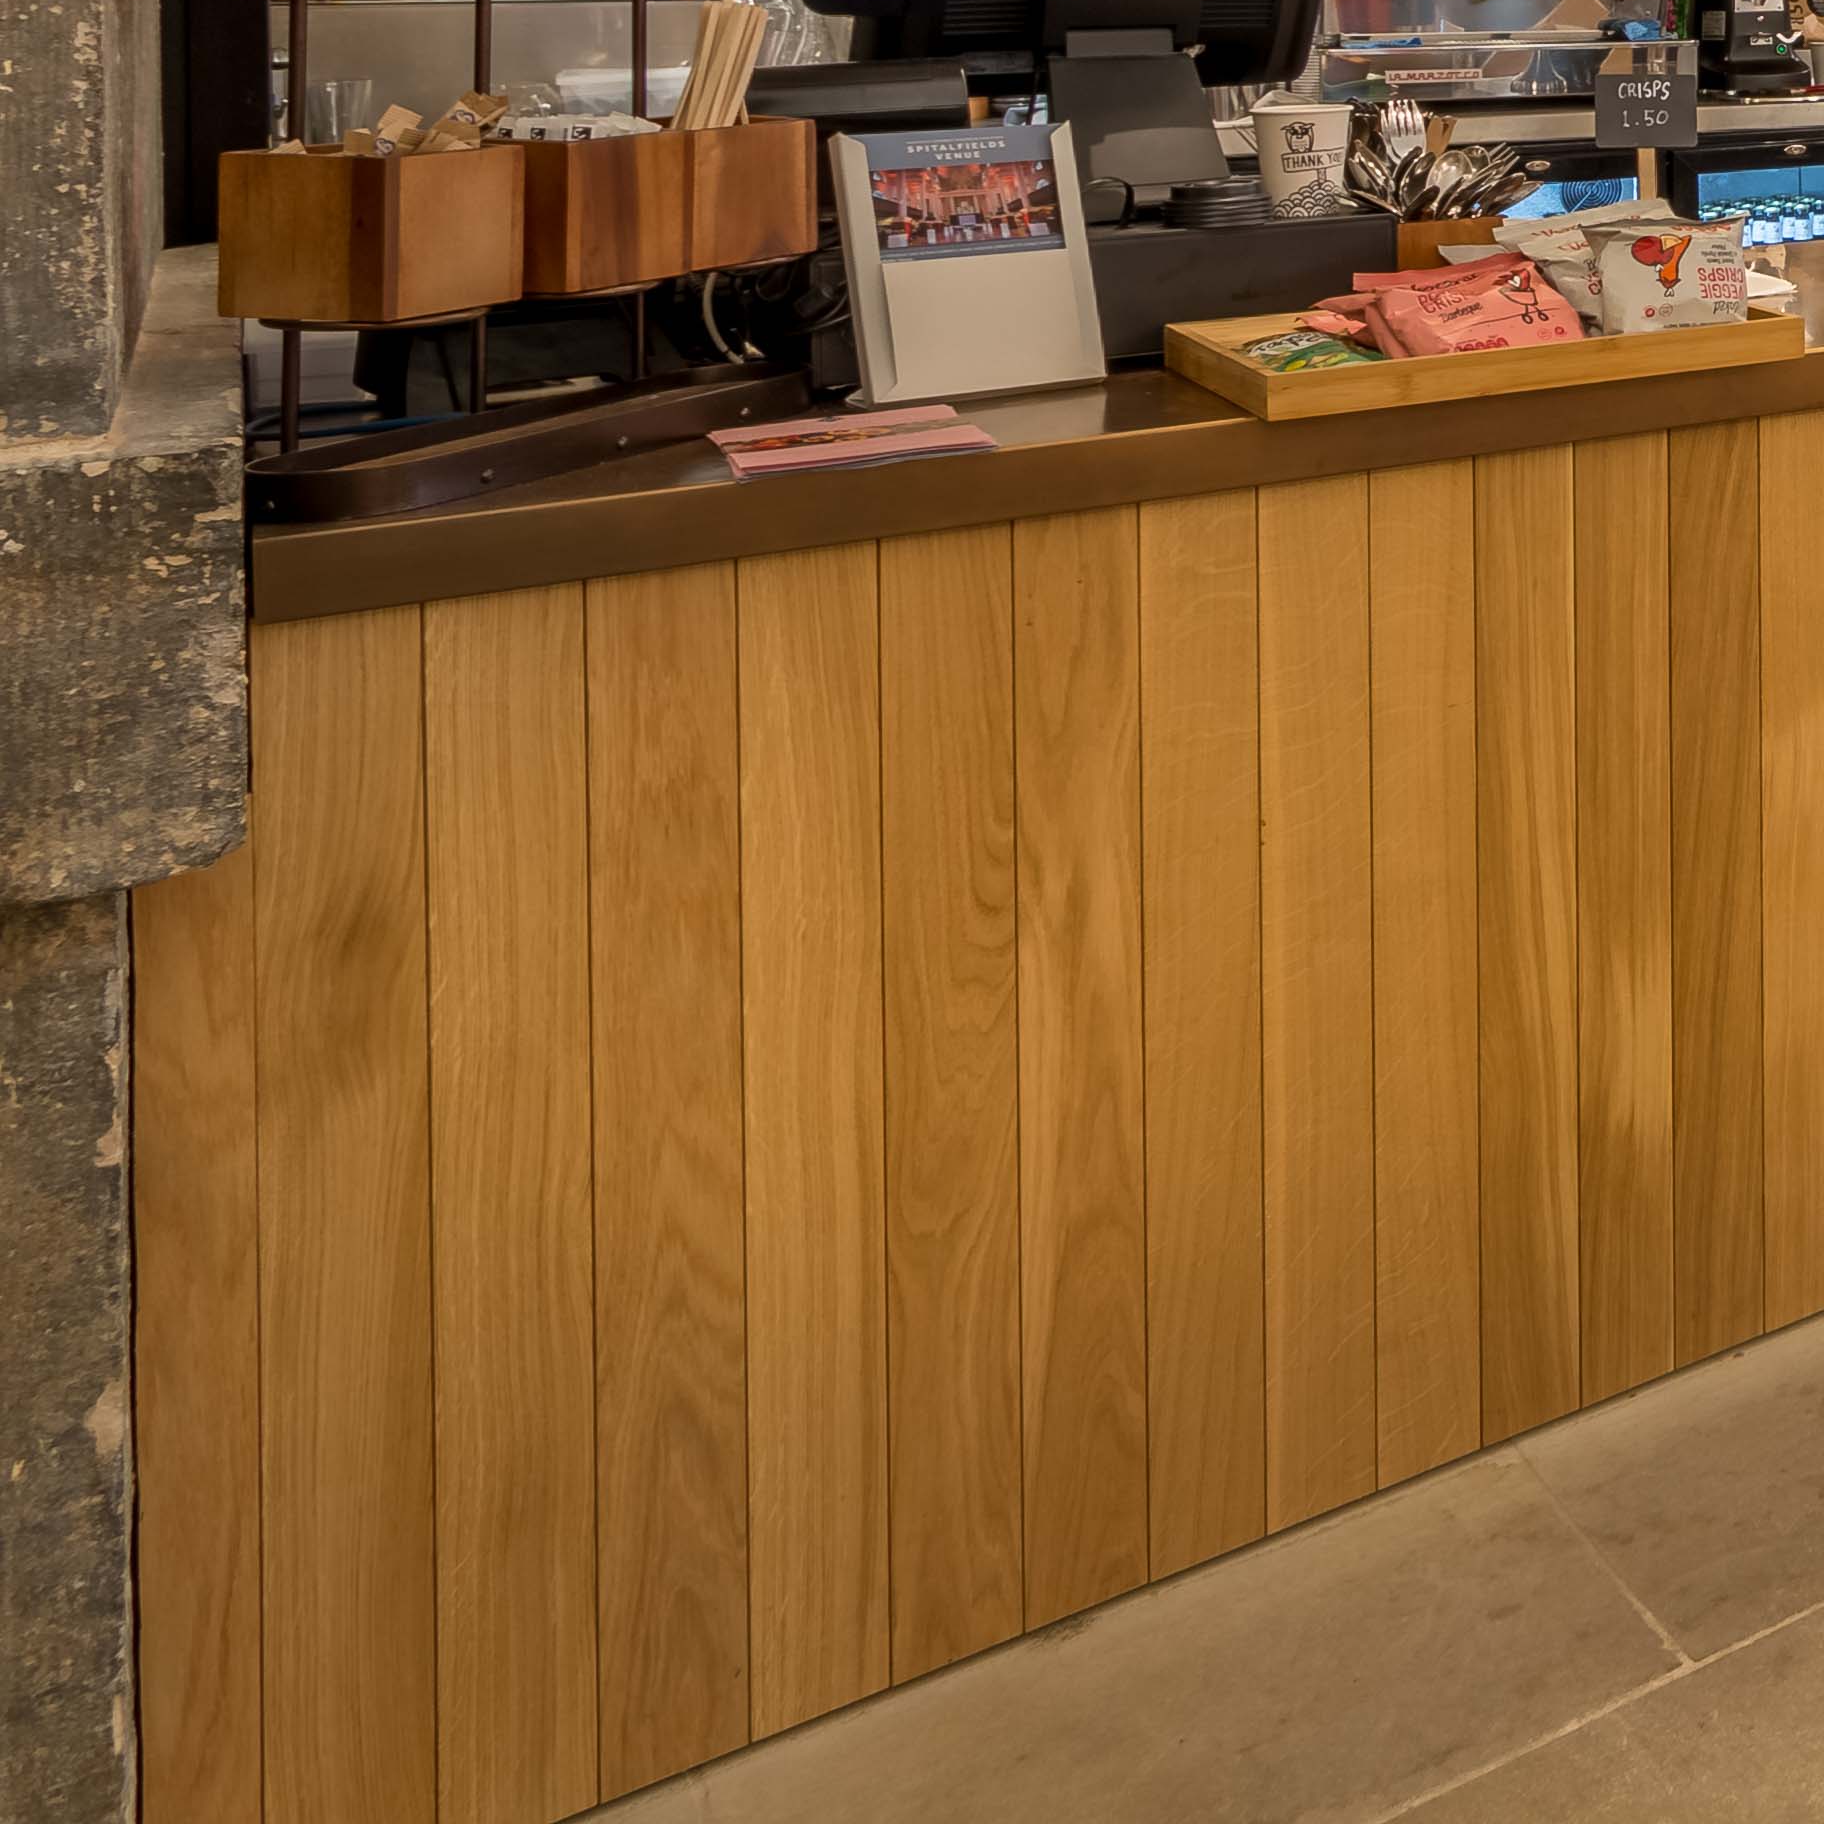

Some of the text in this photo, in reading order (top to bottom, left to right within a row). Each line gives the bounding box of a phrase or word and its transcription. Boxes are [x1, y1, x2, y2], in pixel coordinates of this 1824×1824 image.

[1617, 79, 1671, 101] CRISPS
[1621, 109, 1670, 128] 1.50
[906, 140, 1007, 154] SPITALFIELDS
[935, 151, 982, 161] VENUE
[1283, 154, 1325, 169] THANK
[1698, 267, 1744, 283] CRISPS
[1700, 283, 1744, 299] VEGGIE
